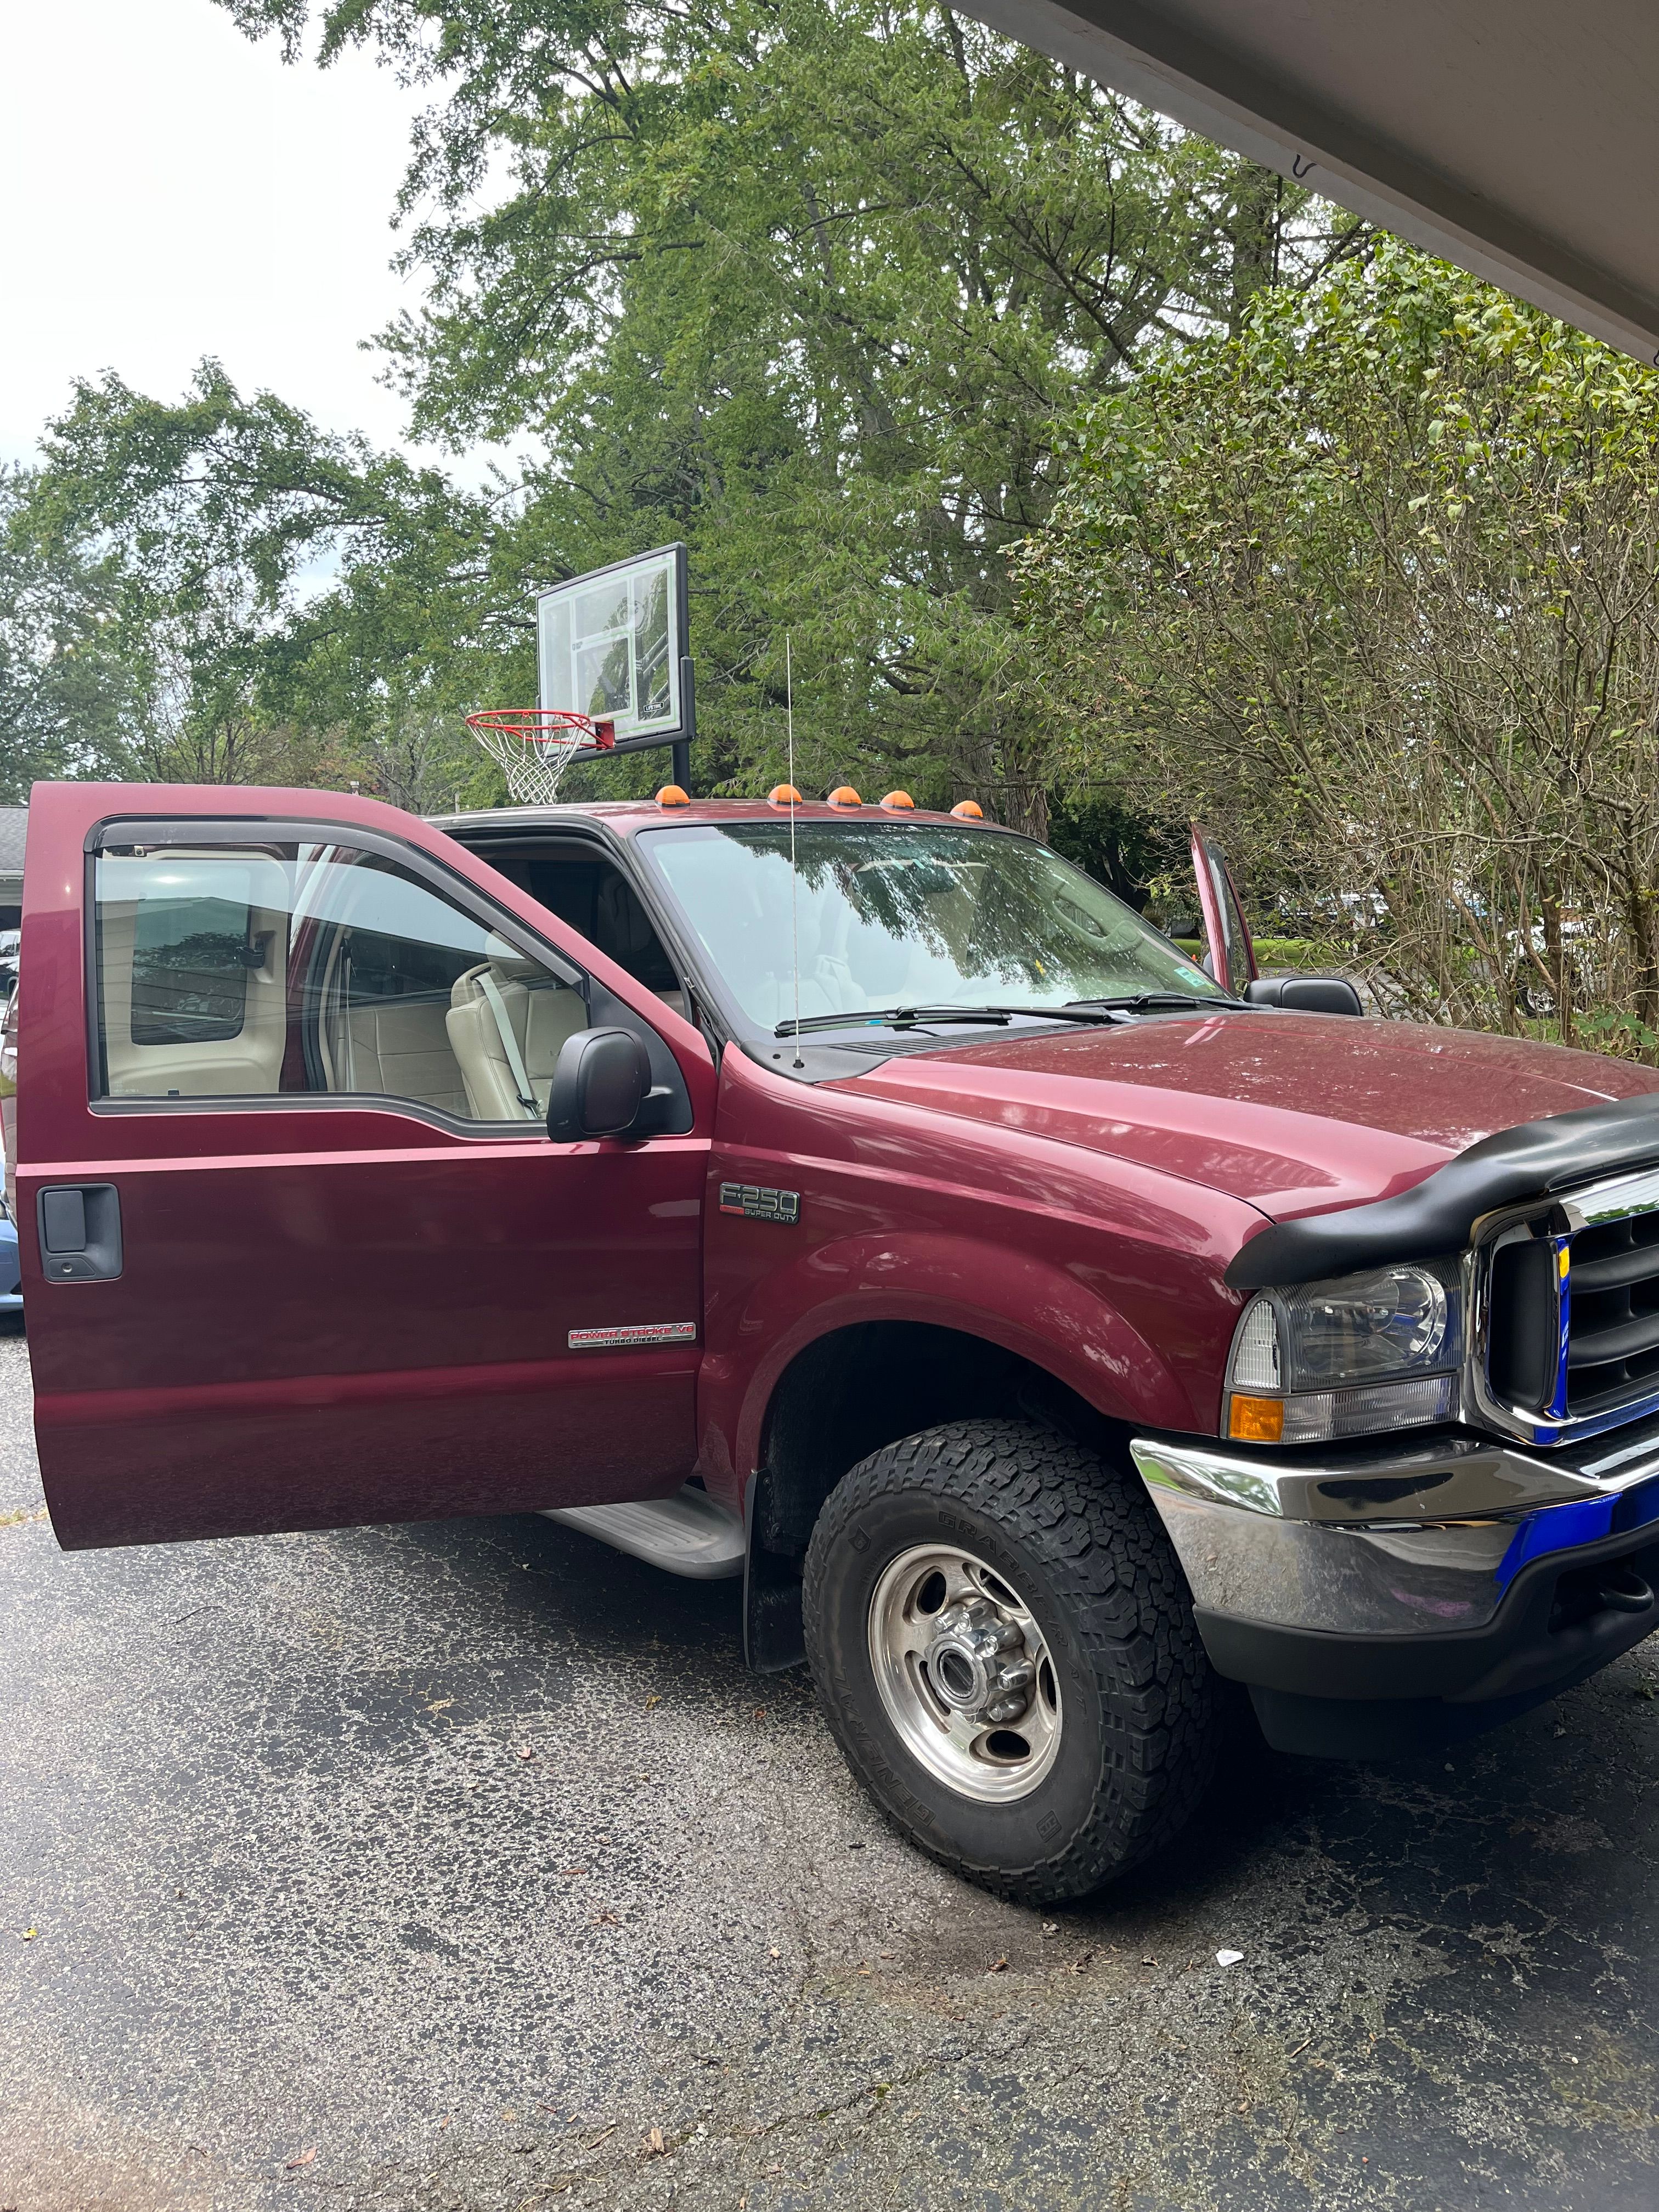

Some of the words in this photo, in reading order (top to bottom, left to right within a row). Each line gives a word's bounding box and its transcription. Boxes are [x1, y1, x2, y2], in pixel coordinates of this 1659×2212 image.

[744, 1208, 771, 1218] SUPER
[774, 1212, 797, 1222] DUTY
[571, 1330, 618, 1340] POWER
[620, 1326, 673, 1336] STROKE
[676, 1324, 694, 1333] V8
[938, 1510, 1069, 1646] GRABBER
[834, 1667, 937, 1827] GENERAL
